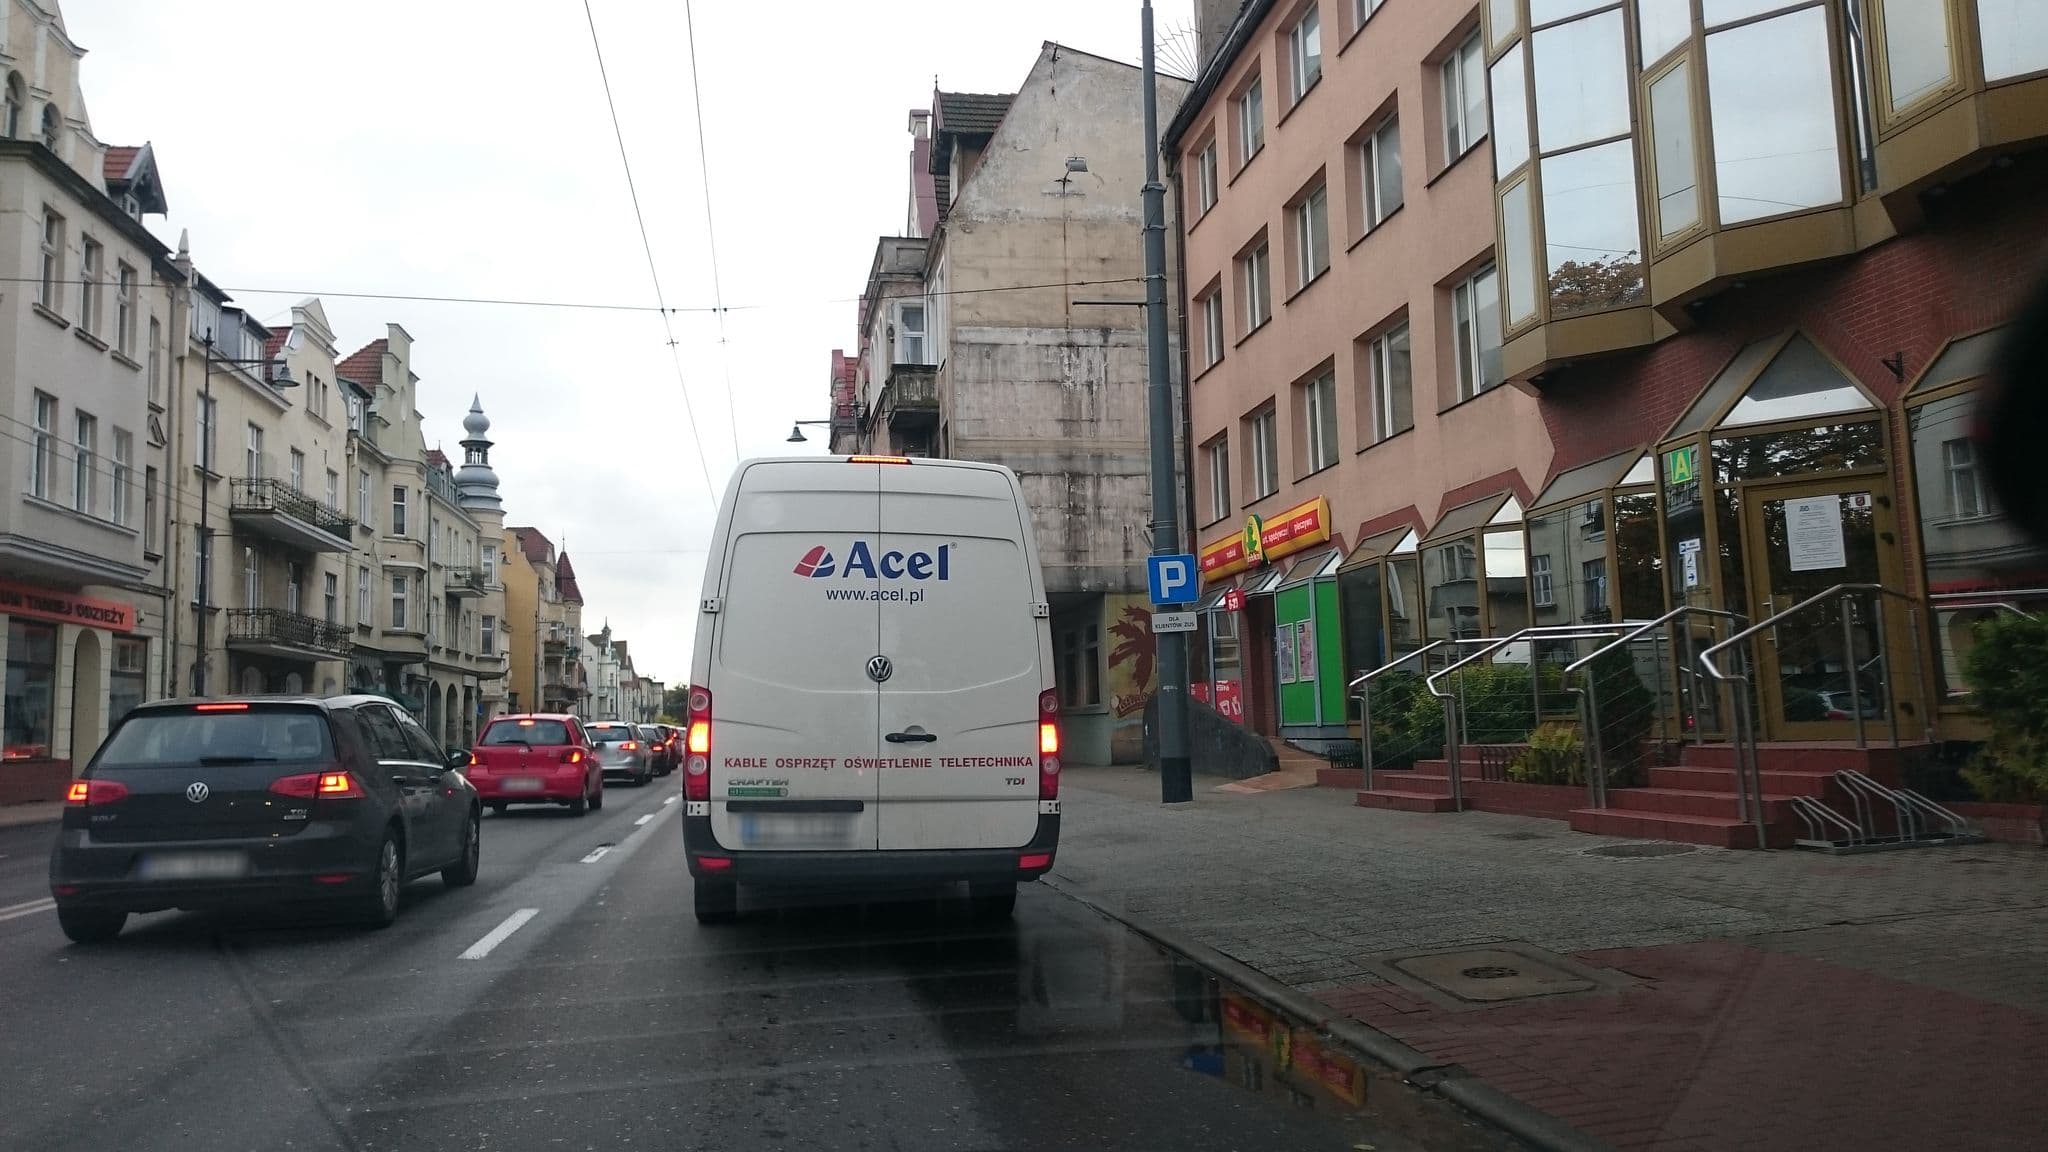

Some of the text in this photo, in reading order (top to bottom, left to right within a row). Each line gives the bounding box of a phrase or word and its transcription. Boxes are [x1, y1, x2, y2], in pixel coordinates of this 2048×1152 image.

[1674, 452, 1690, 480] A
[842, 541, 949, 581] Acel
[1159, 561, 1187, 599] P
[825, 587, 924, 604] www.acel.pl
[724, 756, 1033, 770] KABLE OSPRZĘT OŚWIETLENIE TELETECHNIKA
[1005, 777, 1026, 785] TDI
